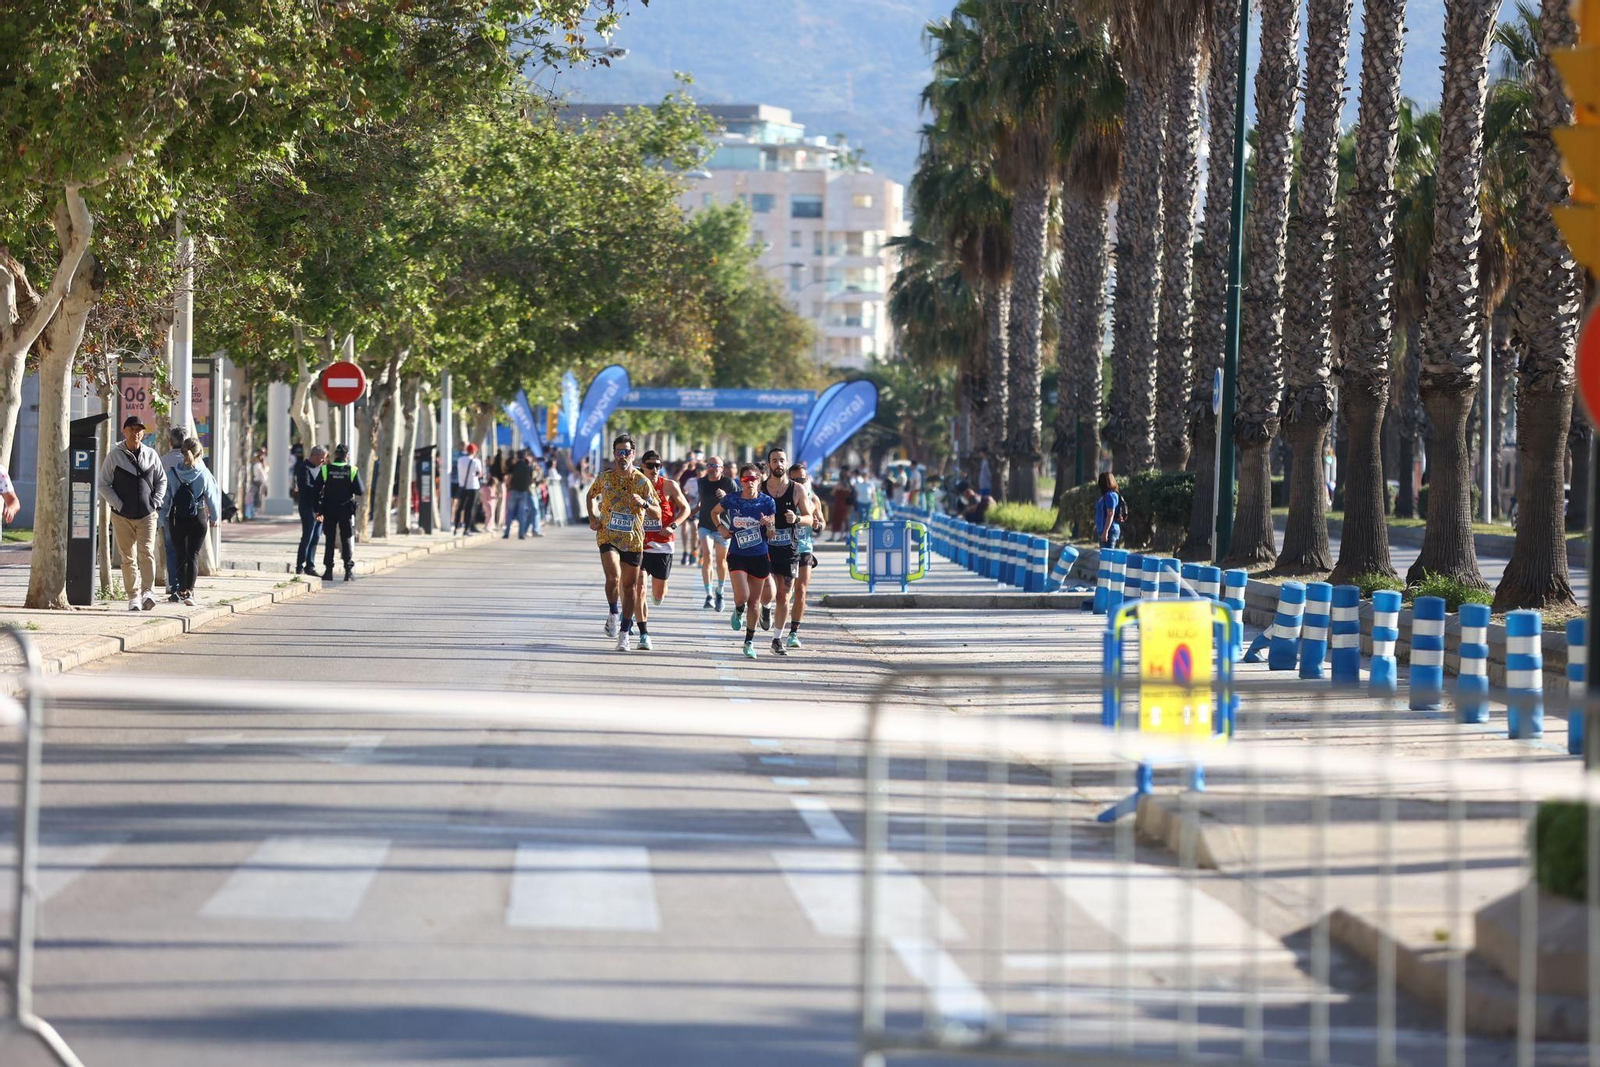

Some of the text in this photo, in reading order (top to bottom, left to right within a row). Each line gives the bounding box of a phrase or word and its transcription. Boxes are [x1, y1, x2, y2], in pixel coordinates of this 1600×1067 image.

[124, 387, 146, 402] 06
[757, 393, 808, 406] mayoral
[125, 403, 145, 411] MAYO
[580, 379, 620, 437] mayoral
[813, 393, 865, 447] mayoral
[75, 451, 88, 467] P
[612, 518, 631, 526] 1894
[740, 532, 759, 543] 1739
